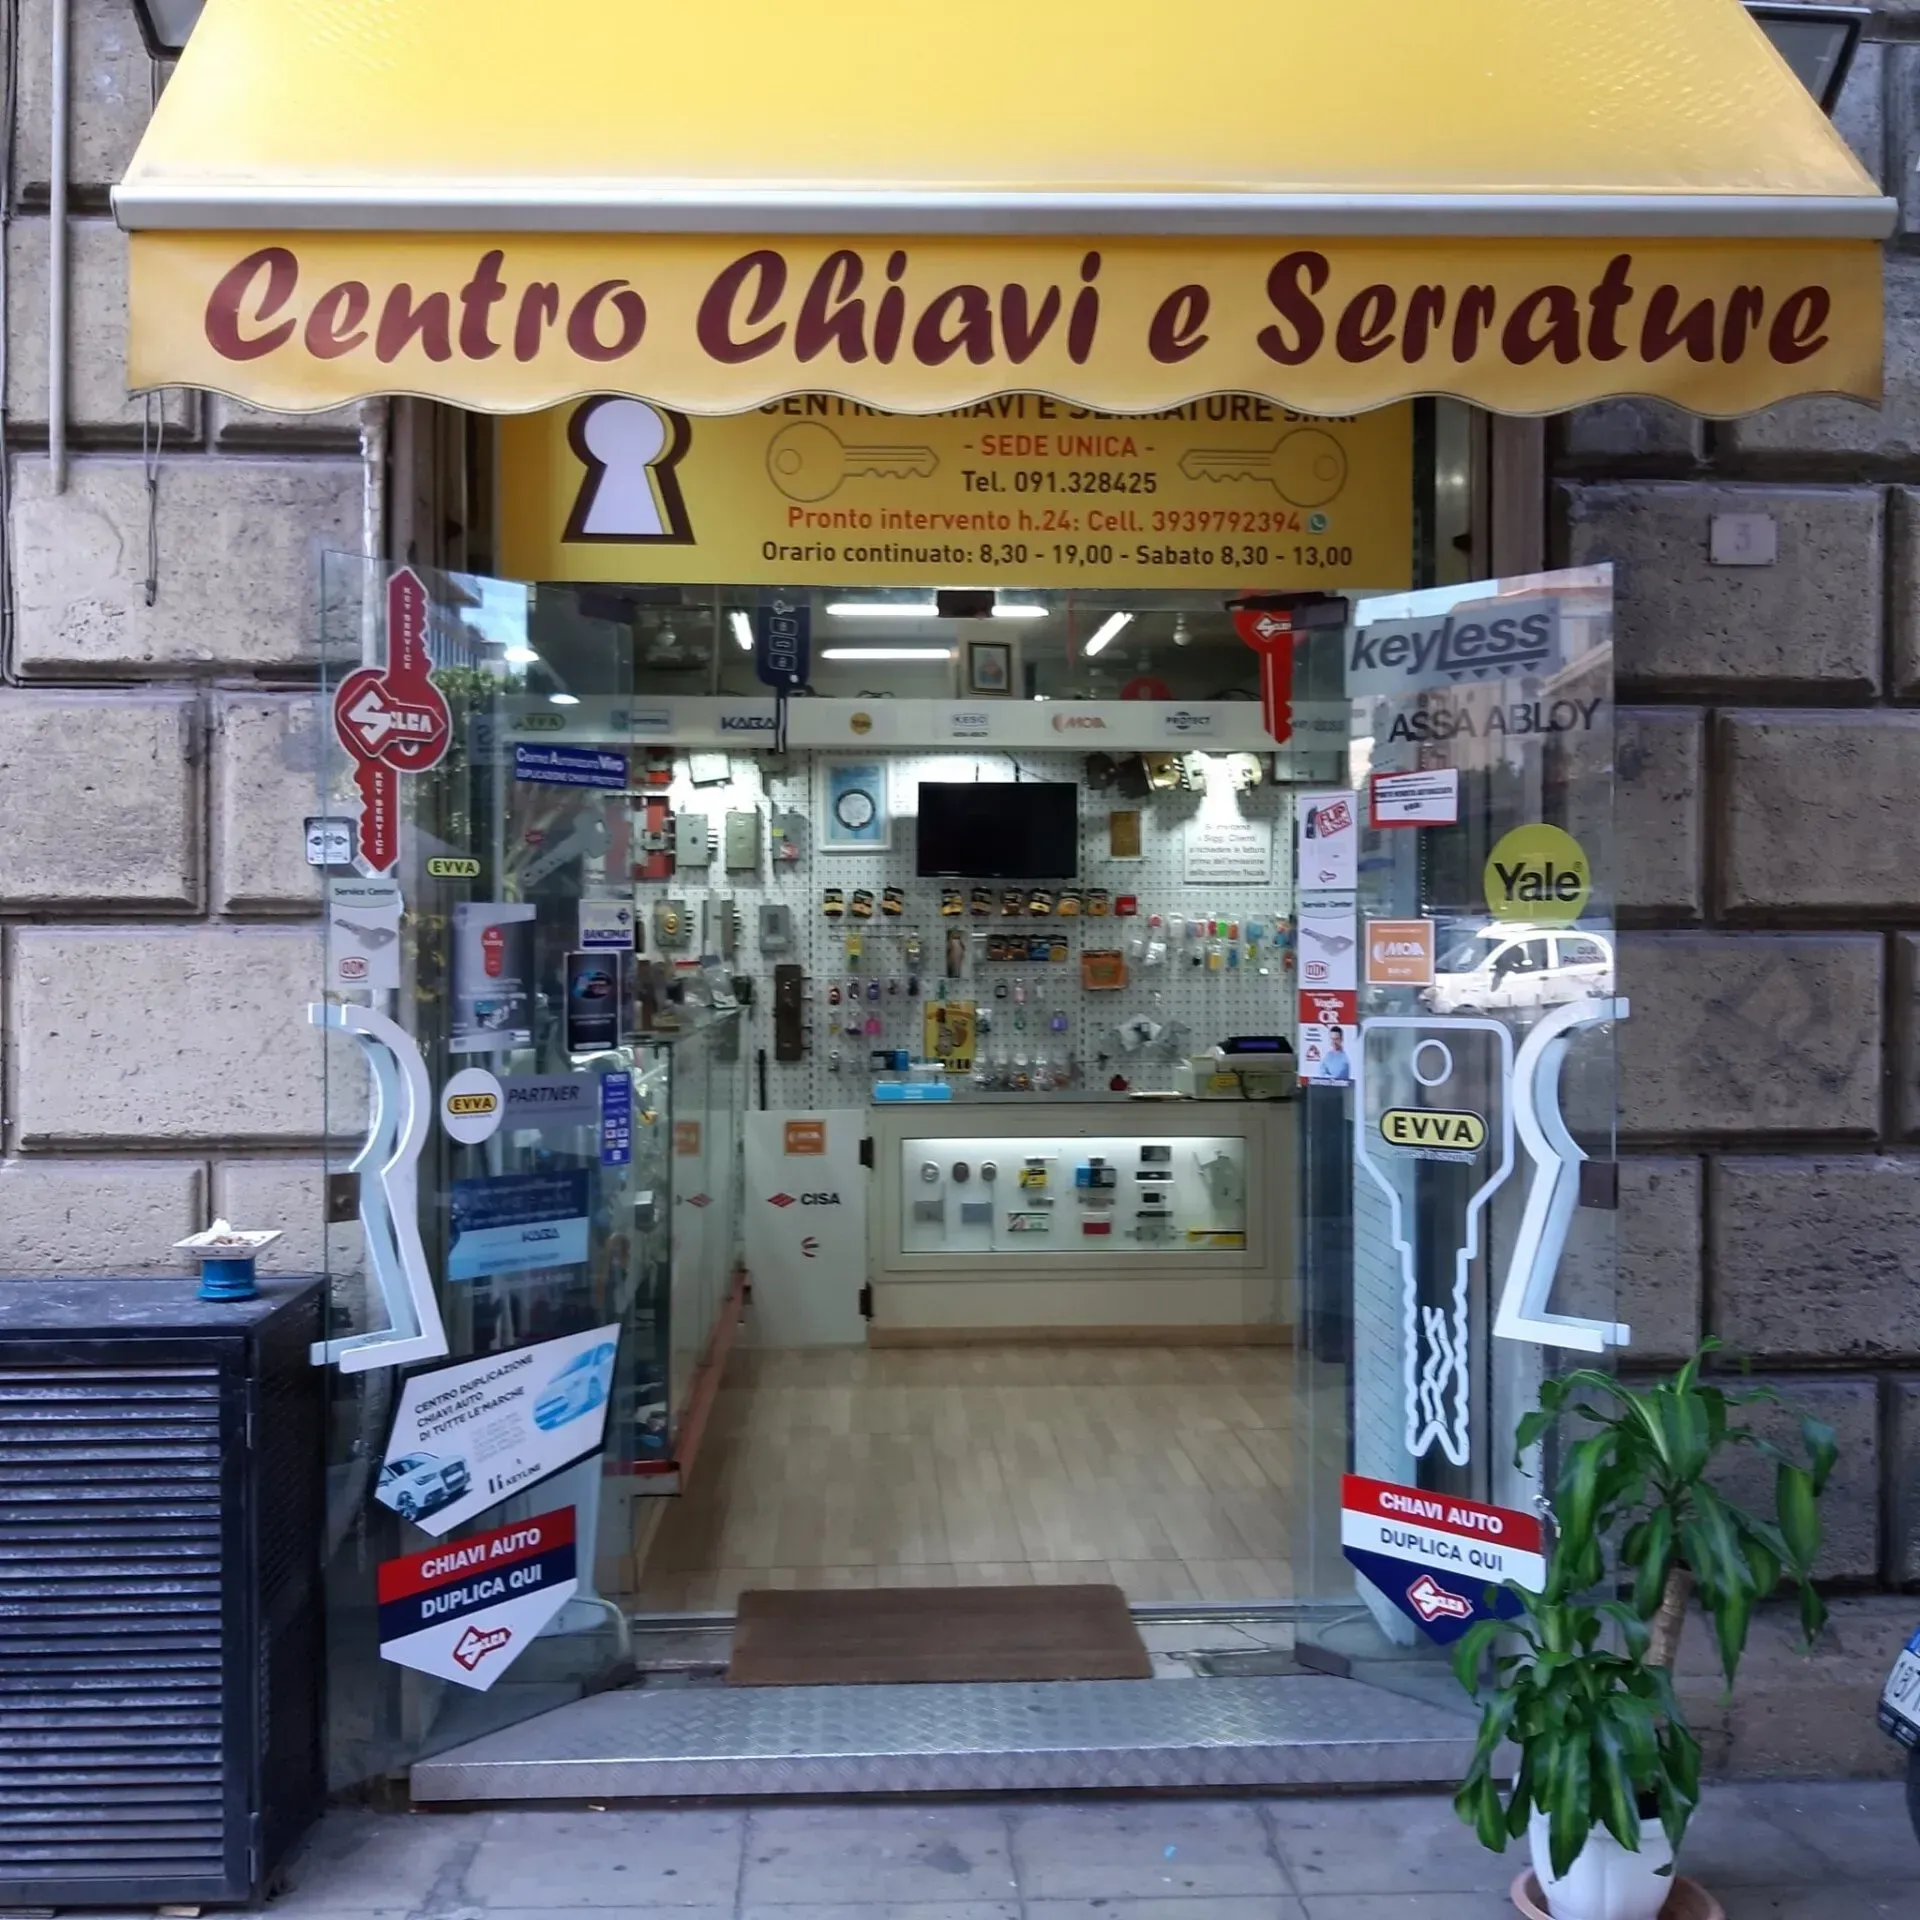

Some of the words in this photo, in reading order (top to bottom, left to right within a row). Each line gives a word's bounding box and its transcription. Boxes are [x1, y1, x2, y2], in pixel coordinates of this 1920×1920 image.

[203, 246, 648, 364] Centro
[695, 250, 1102, 365] Chiavi
[1147, 283, 1211, 364] e
[1256, 250, 1833, 366] Serrature
[980, 434, 1049, 456] SEDE
[1057, 435, 1138, 457] UNICA
[961, 470, 1006, 493] Tel.
[1014, 471, 1157, 494] 091.328425
[788, 506, 872, 529] Pronto
[881, 508, 1011, 531] intervento
[1018, 509, 1080, 531] h.24:
[1088, 510, 1144, 532] Cell.
[1152, 511, 1301, 533] 3939792394
[762, 541, 836, 562] Orario
[843, 543, 973, 564] continuato:
[979, 544, 1028, 566] 8,30
[1054, 545, 1112, 567] 19,00
[1136, 545, 1214, 566] Sabato
[1220, 547, 1269, 568] 8,30
[1293, 547, 1353, 569] 13,00
[1388, 708, 1477, 743] ASSA
[1482, 697, 1603, 736] ABLOY
[433, 860, 476, 874] EVVA
[334, 887, 366, 896] Service
[367, 887, 396, 896] Center
[1492, 861, 1581, 902] Yale
[1302, 900, 1327, 909] Service
[1328, 900, 1353, 908] Center
[453, 1097, 492, 1110] EVVA
[507, 1085, 580, 1102] PARTNER
[1393, 1116, 1475, 1143] EVVA
[800, 1192, 842, 1206] CISA
[414, 1388, 458, 1415] CENTRO
[459, 1353, 534, 1395] DUPLICAZIONE
[416, 1404, 454, 1428] CHIAVI
[452, 1391, 485, 1415] AUTO
[419, 1430, 432, 1442] DI
[433, 1414, 467, 1436] TUTTE
[468, 1405, 482, 1420] LE
[481, 1386, 526, 1412] MARCHE
[505, 1462, 543, 1487] KEYLINE
[1378, 1491, 1443, 1520] CHIAVI
[1447, 1506, 1503, 1534] AUTO
[421, 1543, 486, 1579] CHIAVI
[489, 1527, 542, 1558] AUTO
[1380, 1527, 1462, 1562] DUPLICA
[1469, 1549, 1504, 1572] QUI
[421, 1576, 507, 1619] DUPLICA
[509, 1563, 543, 1589] QUI
